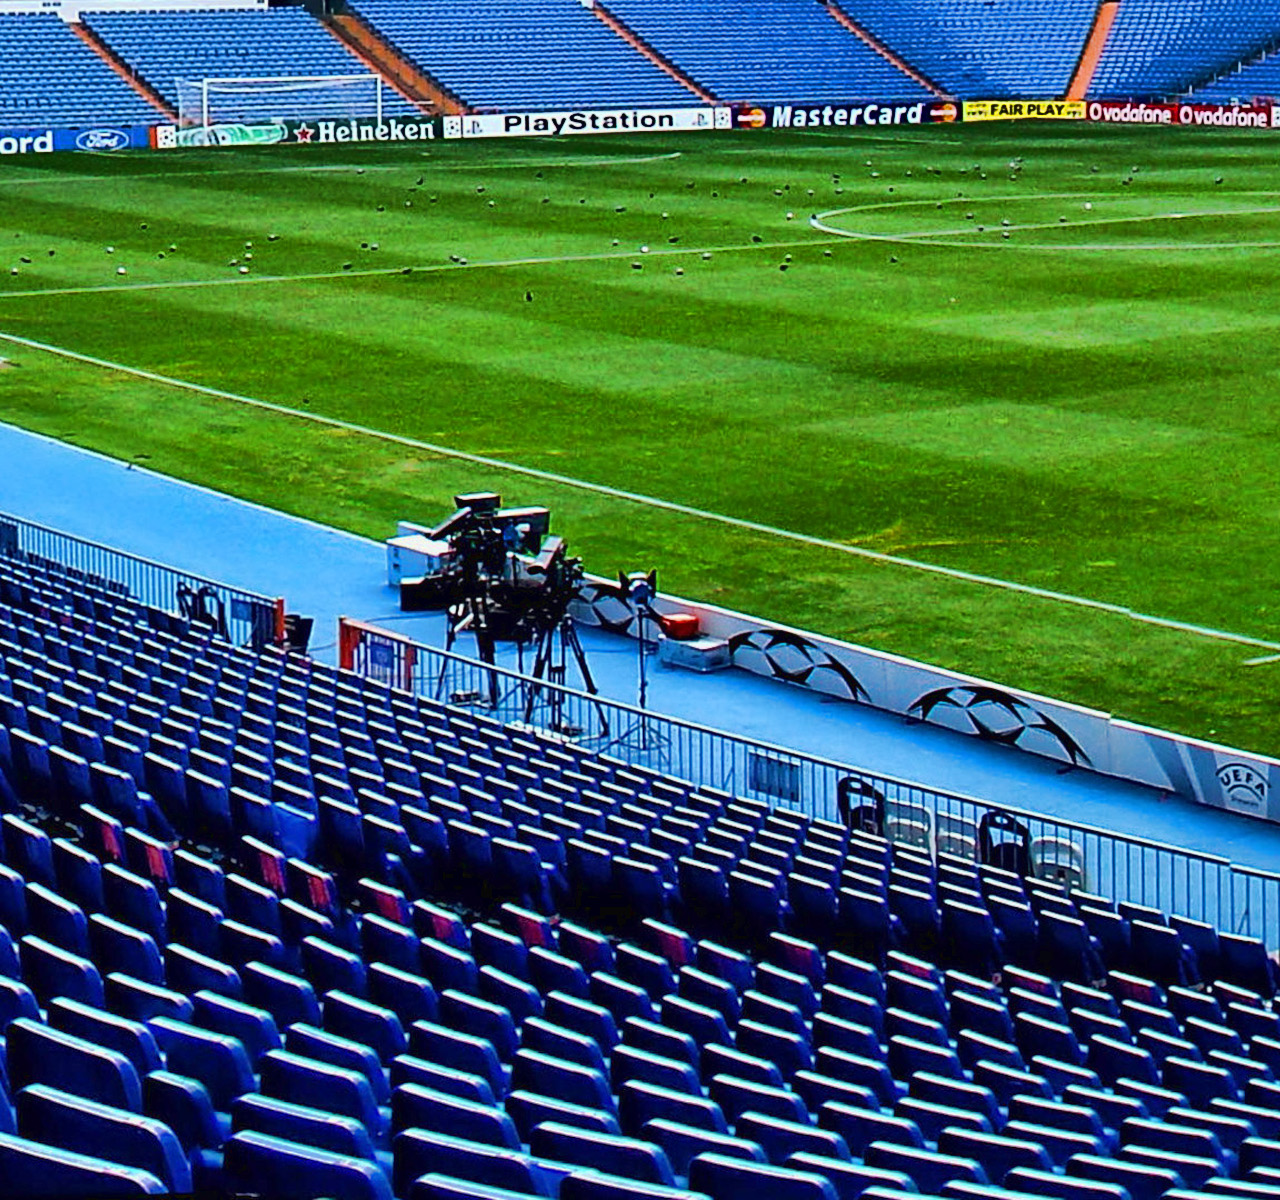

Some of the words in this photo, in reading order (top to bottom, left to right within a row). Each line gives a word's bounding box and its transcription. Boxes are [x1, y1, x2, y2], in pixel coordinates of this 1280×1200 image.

[503, 109, 674, 134] PlayStation
[772, 103, 923, 128] MasterCard
[990, 104, 1023, 115] FAIR
[1027, 103, 1067, 116] PLAY
[319, 120, 434, 144] Heineken
[1220, 769, 1265, 796] UEFA
